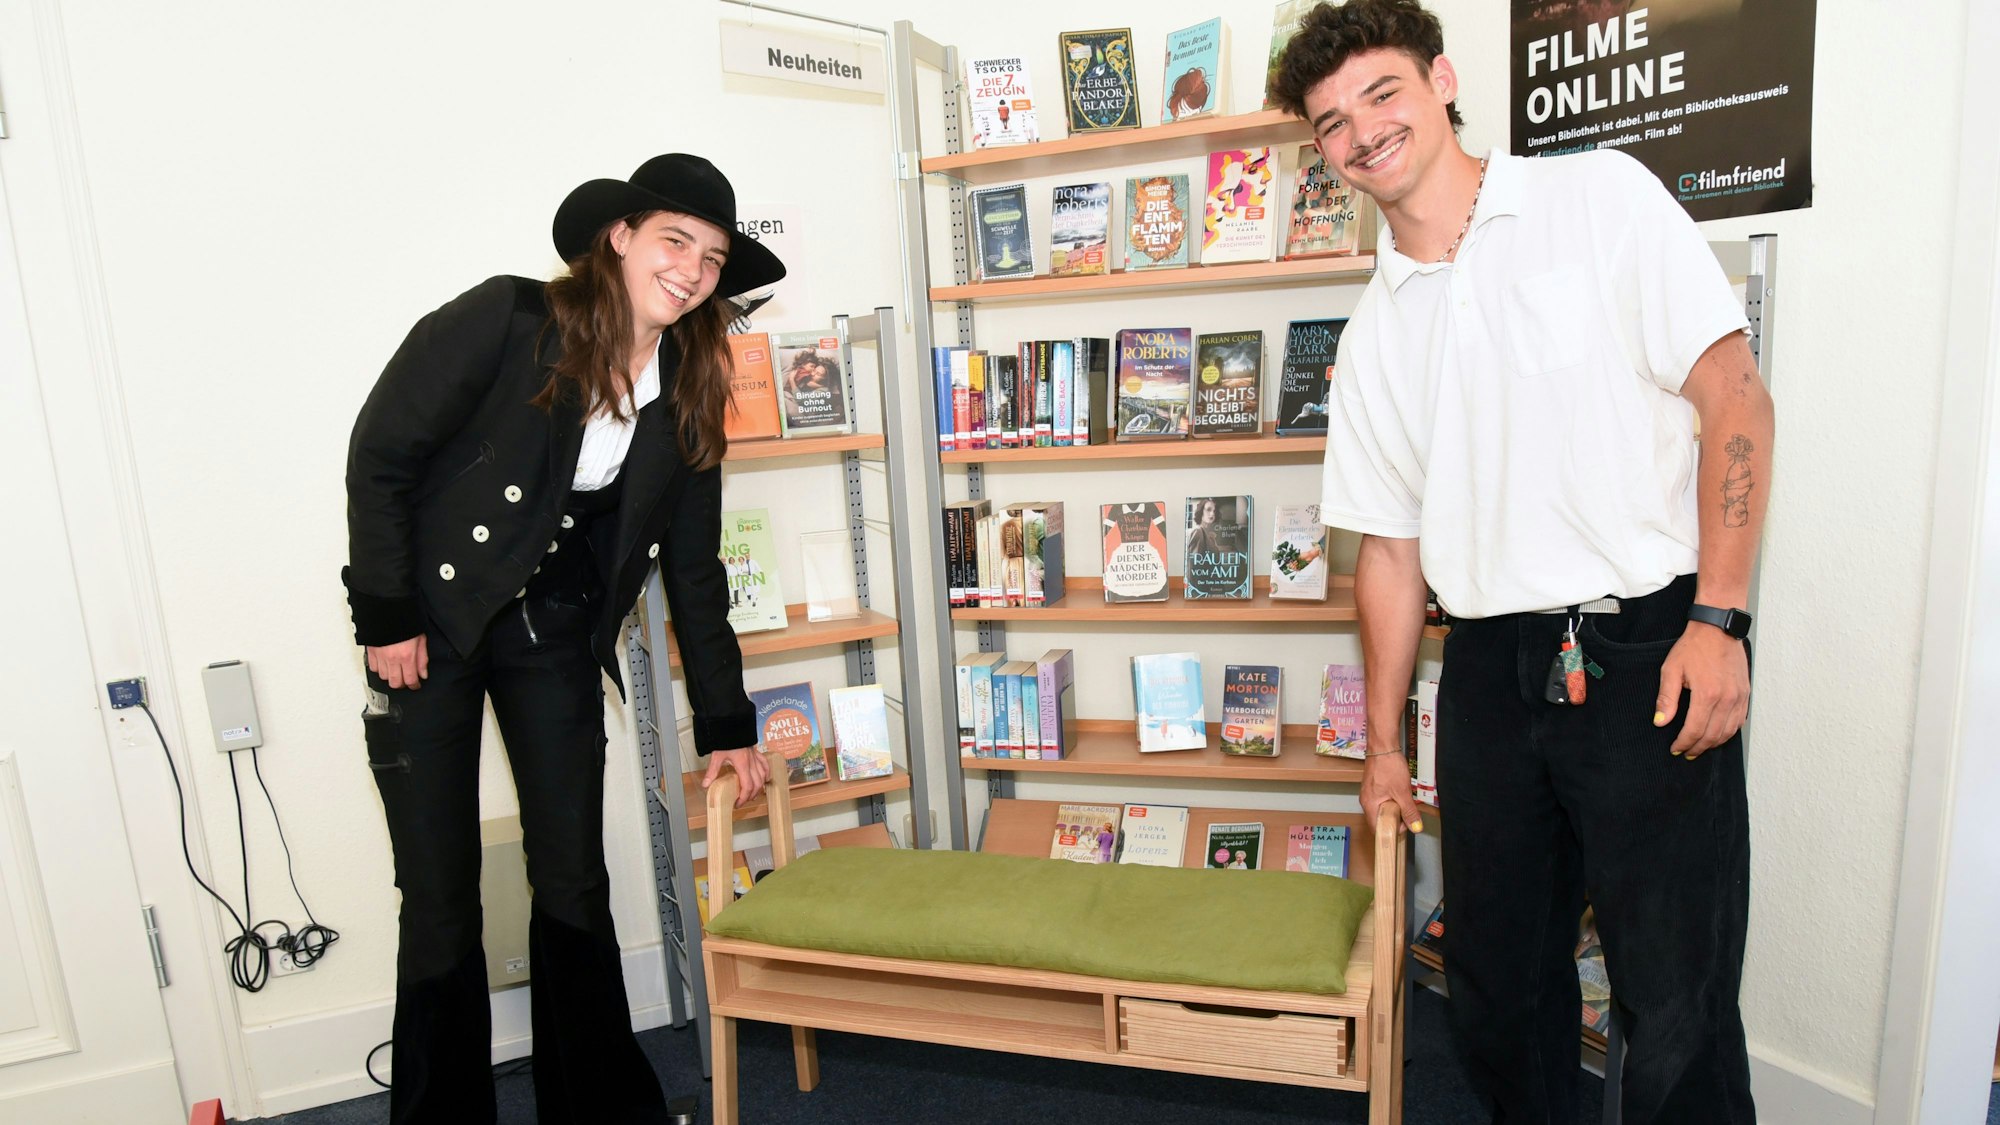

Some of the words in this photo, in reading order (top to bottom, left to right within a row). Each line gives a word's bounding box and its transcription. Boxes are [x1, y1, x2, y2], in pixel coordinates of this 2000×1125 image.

[1192, 33, 1209, 45] Beste
[1528, 7, 1649, 78] FILME
[1197, 42, 1213, 53] noch
[768, 48, 862, 80] Neuheiten
[974, 58, 1021, 68] SCHWIECKER
[975, 65, 1022, 74] TSOKOS
[982, 78, 1002, 86] DIE
[1087, 78, 1117, 88] ERBE
[1526, 51, 1685, 124] ONLINE
[976, 85, 1025, 98] ZEUGIN
[1072, 88, 1133, 100] PANDORA
[1083, 100, 1124, 111] BLAKE
[1528, 135, 1556, 148] Unsere
[1558, 124, 1600, 141] Bibliothek
[1602, 121, 1614, 132] ist
[1615, 114, 1643, 129] dabei.
[1645, 110, 1660, 123] Mit
[1662, 107, 1683, 119] dem
[1686, 84, 1789, 115] Bibliotheksausweis
[1542, 143, 1594, 158] filmfriend.de
[1597, 134, 1642, 150] anmelden.
[1645, 128, 1665, 140] Film
[1667, 123, 1683, 136] ab!
[1308, 165, 1325, 176] DIE
[1698, 158, 1785, 190] filmfriend
[1055, 186, 1087, 200] nora
[1299, 180, 1341, 194] FORMEL
[1694, 191, 1722, 200] streamen
[1754, 180, 1784, 191] Bibliothek
[1055, 198, 1107, 214] roberts
[1146, 200, 1169, 212] DIE
[1326, 195, 1348, 207] DER
[1144, 210, 1171, 223] ENT
[1294, 211, 1354, 228] HOFFNUNG
[1132, 221, 1182, 236] FLAMM
[1143, 234, 1171, 245] TEN
[1291, 325, 1325, 336] MARY
[1136, 333, 1176, 346] NORA
[1200, 336, 1230, 345] HARLAN
[1231, 334, 1258, 343] COBEN
[1290, 334, 1340, 346] HIGGIN
[1124, 346, 1189, 360] ROBERTS
[1288, 344, 1328, 356] CLARK
[1288, 356, 1320, 365] ALAFAIR
[1285, 372, 1315, 380] DUNKEL
[732, 381, 768, 392] NSUM
[796, 392, 832, 400] Bindung
[1199, 387, 1256, 402] NICHTS
[804, 398, 825, 406] ohne
[1206, 402, 1246, 413] BLEIBT
[798, 404, 832, 413] Burnout
[1194, 412, 1257, 425] BEGRABEN
[1126, 545, 1145, 553] DER
[1117, 554, 1155, 563] DIENST-
[1189, 551, 1248, 565] FRÄULEIN
[1110, 563, 1163, 573] MÄDCHEN-
[1211, 566, 1239, 578] AMT
[1117, 572, 1157, 582] MÖRDER
[1239, 672, 1267, 682] KATE
[1226, 684, 1278, 694] MORTON
[1332, 687, 1362, 705] Meer
[759, 696, 808, 717] Niederlande
[1226, 707, 1275, 715] VERBORGENE
[770, 717, 802, 732] SOUL
[766, 725, 810, 741] PLACES
[1290, 833, 1347, 841] HÜLSMANN
[1128, 845, 1168, 855] Lorenz
